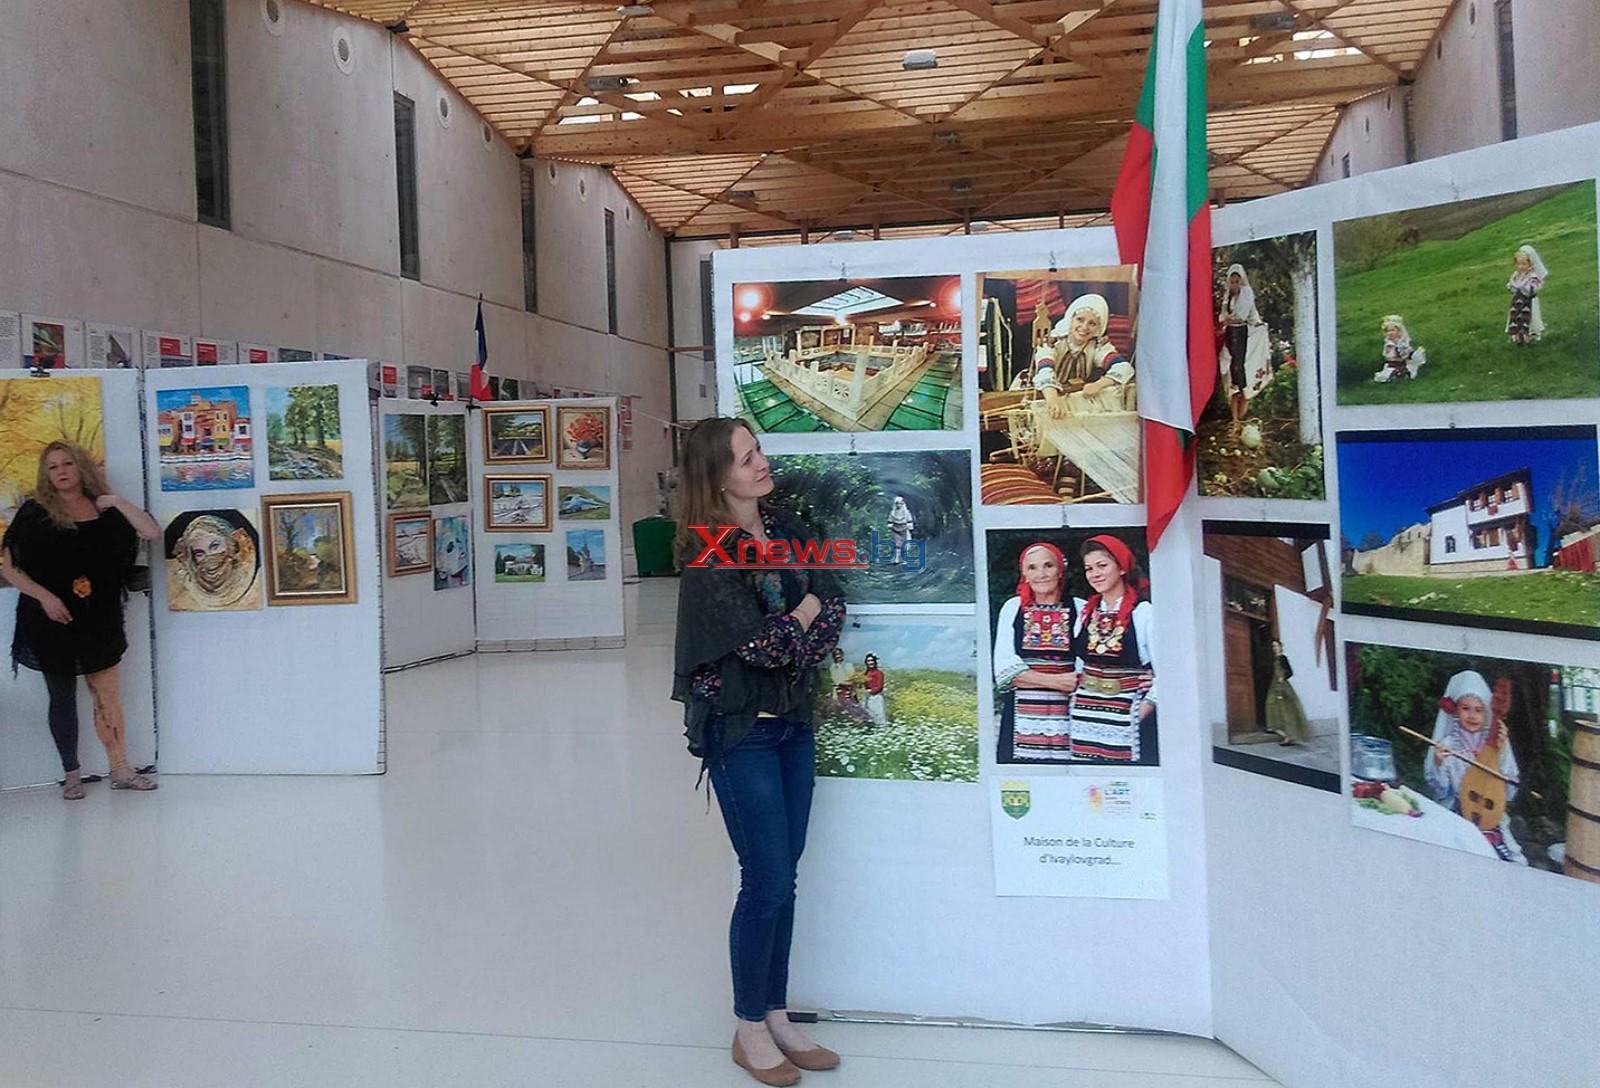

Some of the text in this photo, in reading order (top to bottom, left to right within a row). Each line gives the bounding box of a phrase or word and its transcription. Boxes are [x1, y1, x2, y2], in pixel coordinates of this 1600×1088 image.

[1024, 836, 1135, 849] Maison de la Culture
